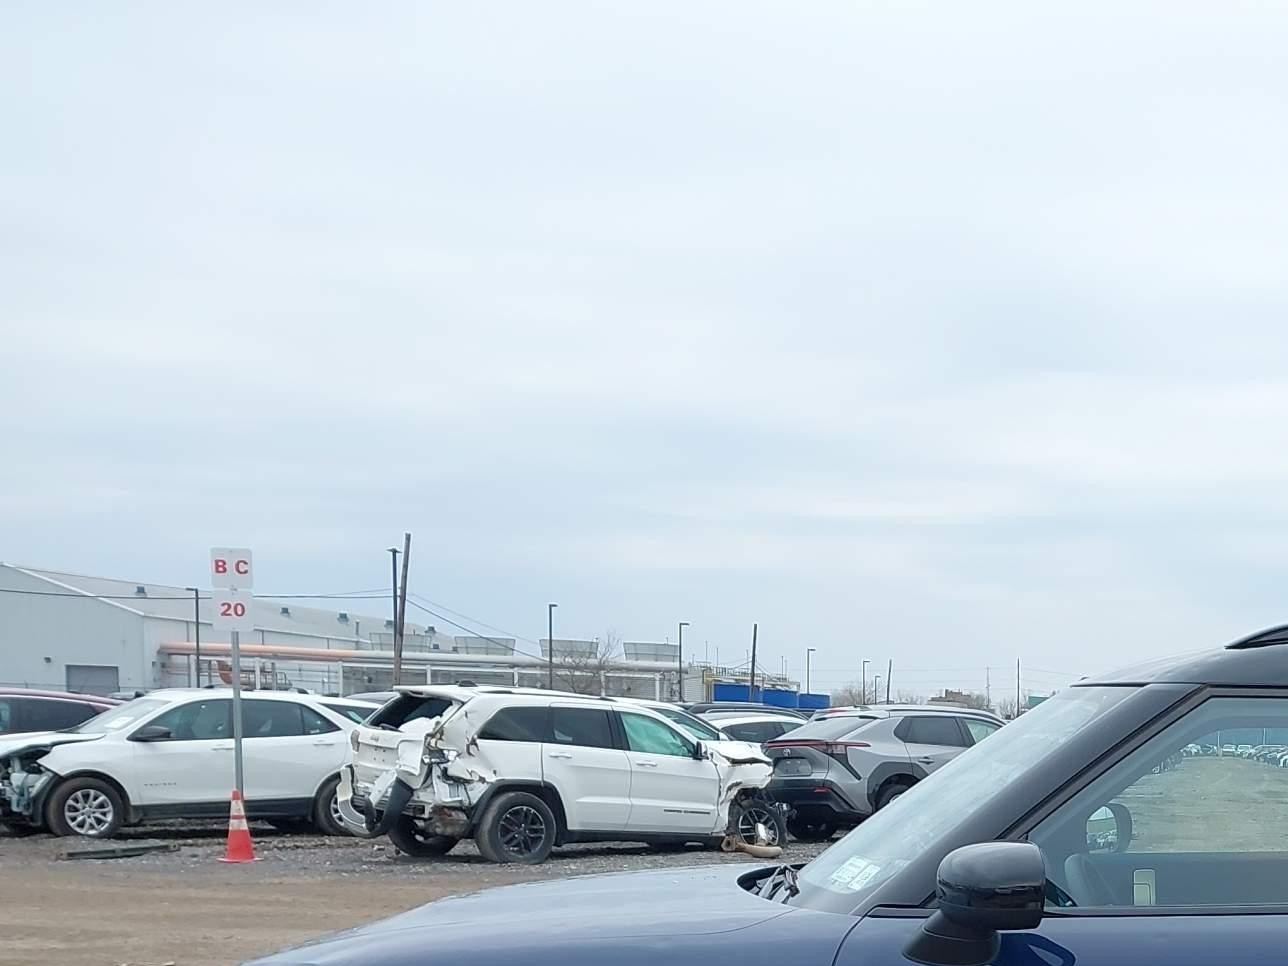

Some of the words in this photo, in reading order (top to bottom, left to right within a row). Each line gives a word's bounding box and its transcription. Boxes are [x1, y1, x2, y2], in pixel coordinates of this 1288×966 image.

[214, 559, 227, 574] B
[235, 559, 249, 575] C
[220, 602, 246, 617] 20
